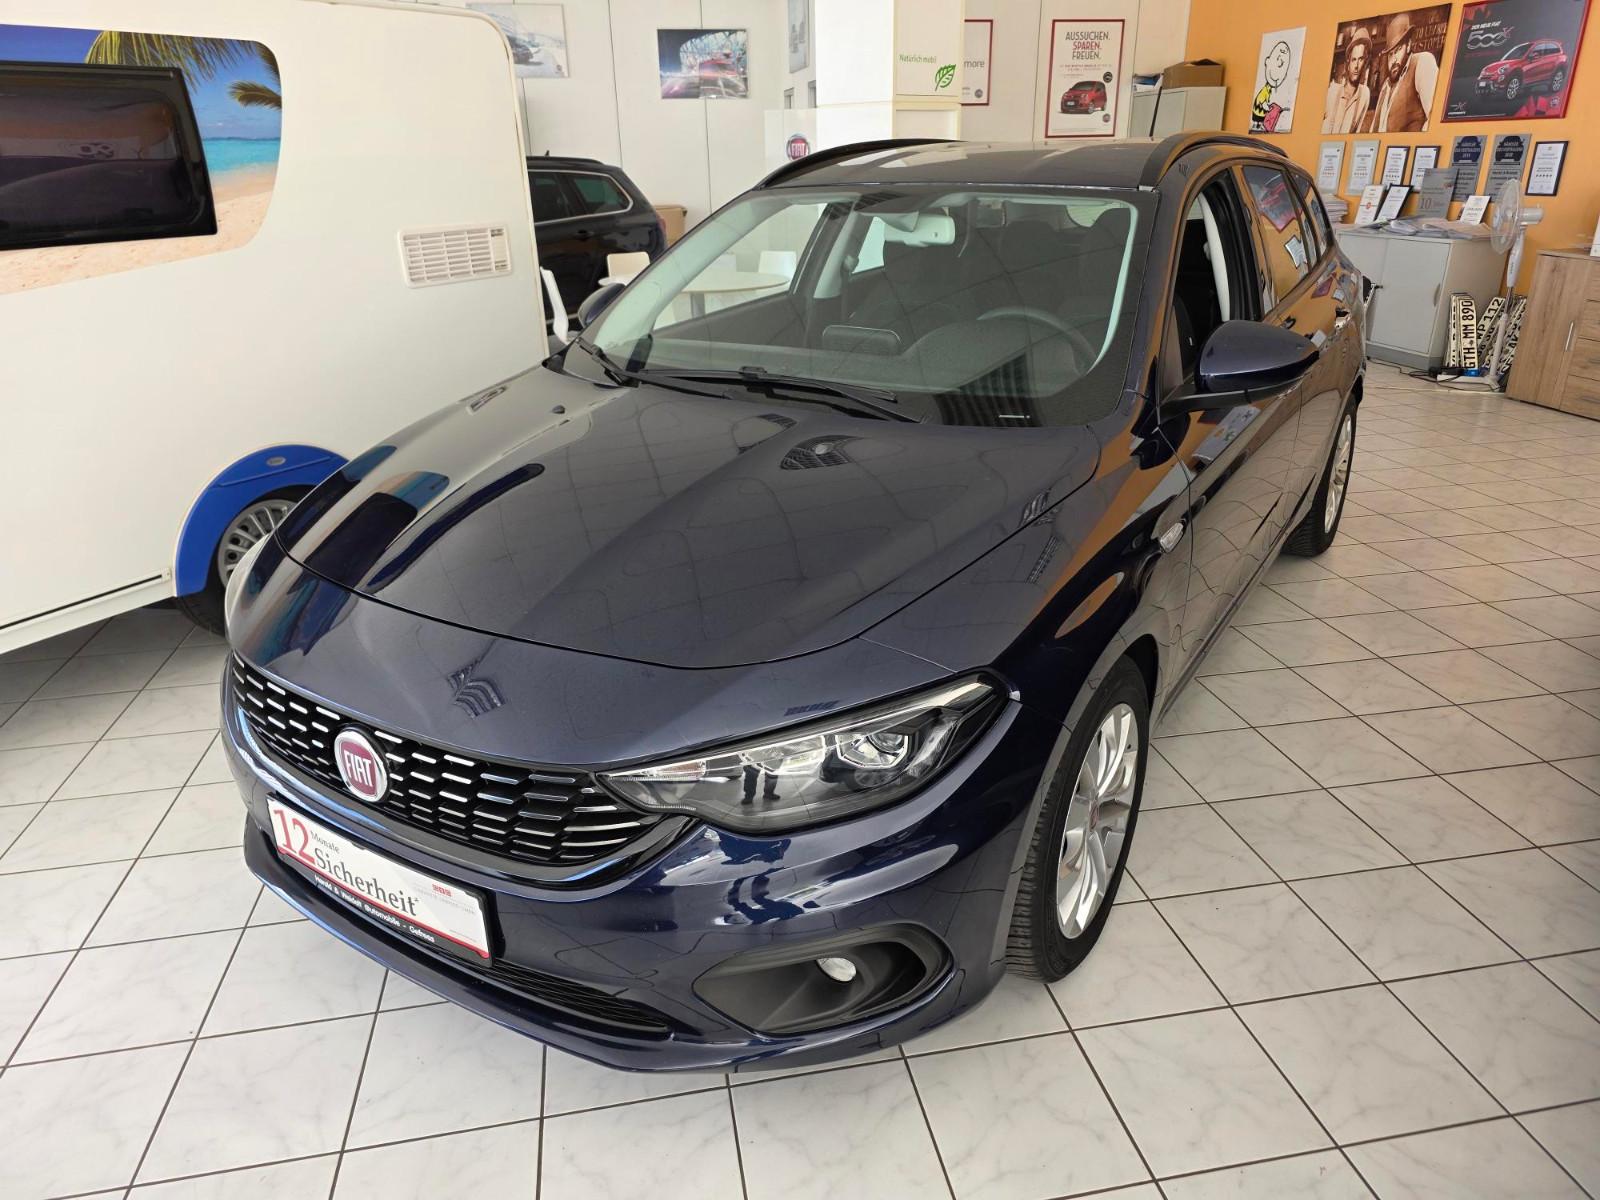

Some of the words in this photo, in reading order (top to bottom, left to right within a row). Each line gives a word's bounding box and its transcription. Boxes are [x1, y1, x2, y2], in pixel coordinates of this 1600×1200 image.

[1065, 31, 1111, 41] AUSSUCHEN.
[1072, 41, 1102, 50] SPAREN.
[963, 60, 985, 68] more
[1072, 51, 1101, 60] FREUEN.
[791, 143, 806, 157] FIAT
[1462, 300, 1474, 323] 890
[1483, 299, 1502, 322] 112
[1463, 324, 1475, 339] MM
[1463, 346, 1475, 368] GTH
[343, 750, 373, 787] FIAT
[273, 809, 316, 865] 12
[310, 831, 340, 854] Monate
